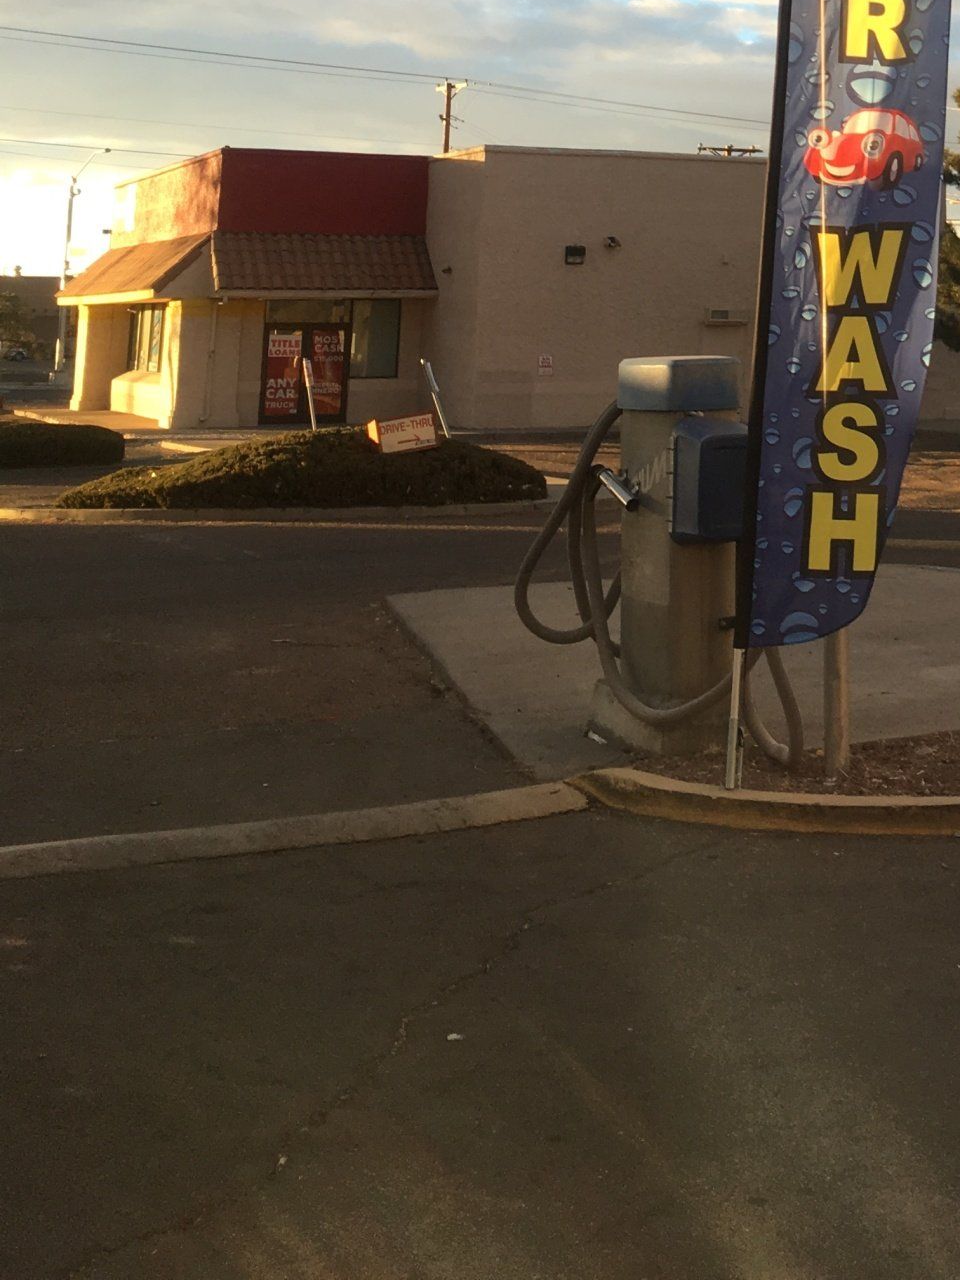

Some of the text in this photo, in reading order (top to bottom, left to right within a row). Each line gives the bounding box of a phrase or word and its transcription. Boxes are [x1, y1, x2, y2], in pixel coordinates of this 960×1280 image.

[271, 339, 300, 348] TITLE
[314, 344, 344, 353] CASH
[266, 378, 296, 388] ANY
[807, 228, 905, 573] WASH
[380, 417, 434, 435] DRIVE-THRU
